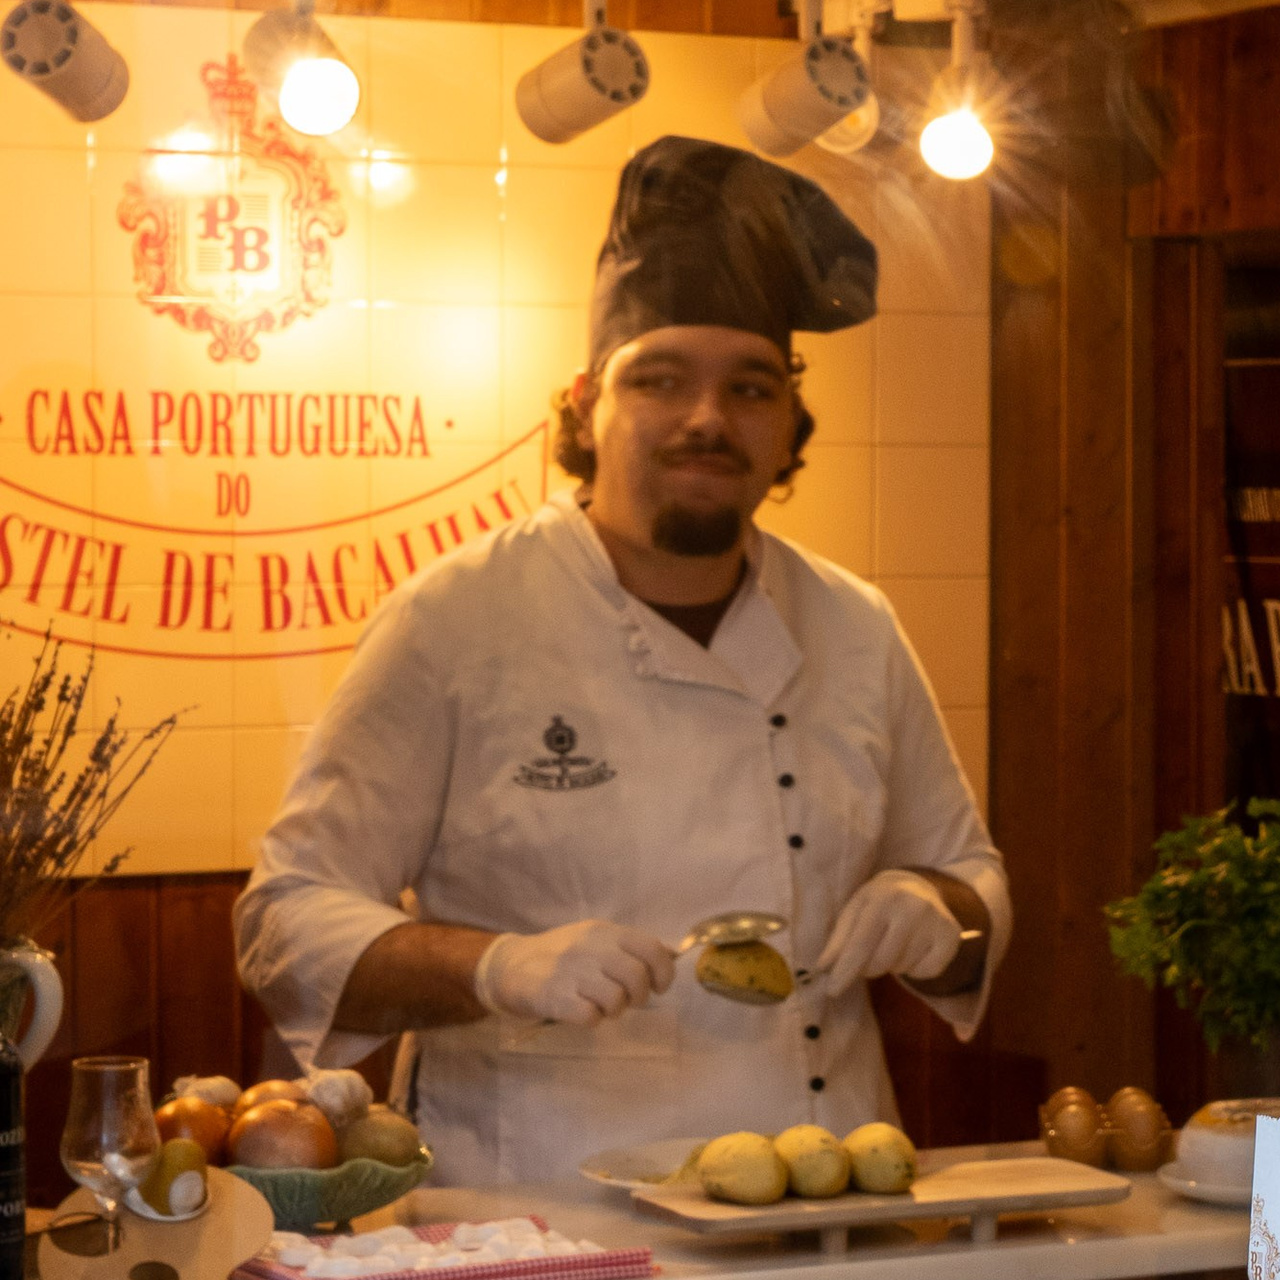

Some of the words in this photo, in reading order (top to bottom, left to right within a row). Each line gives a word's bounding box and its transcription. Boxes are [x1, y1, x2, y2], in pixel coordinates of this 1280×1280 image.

[26, 388, 136, 456] CASA
[149, 390, 432, 459] PORTUGUESA
[215, 471, 251, 518] DO
[156, 547, 236, 633] DE
